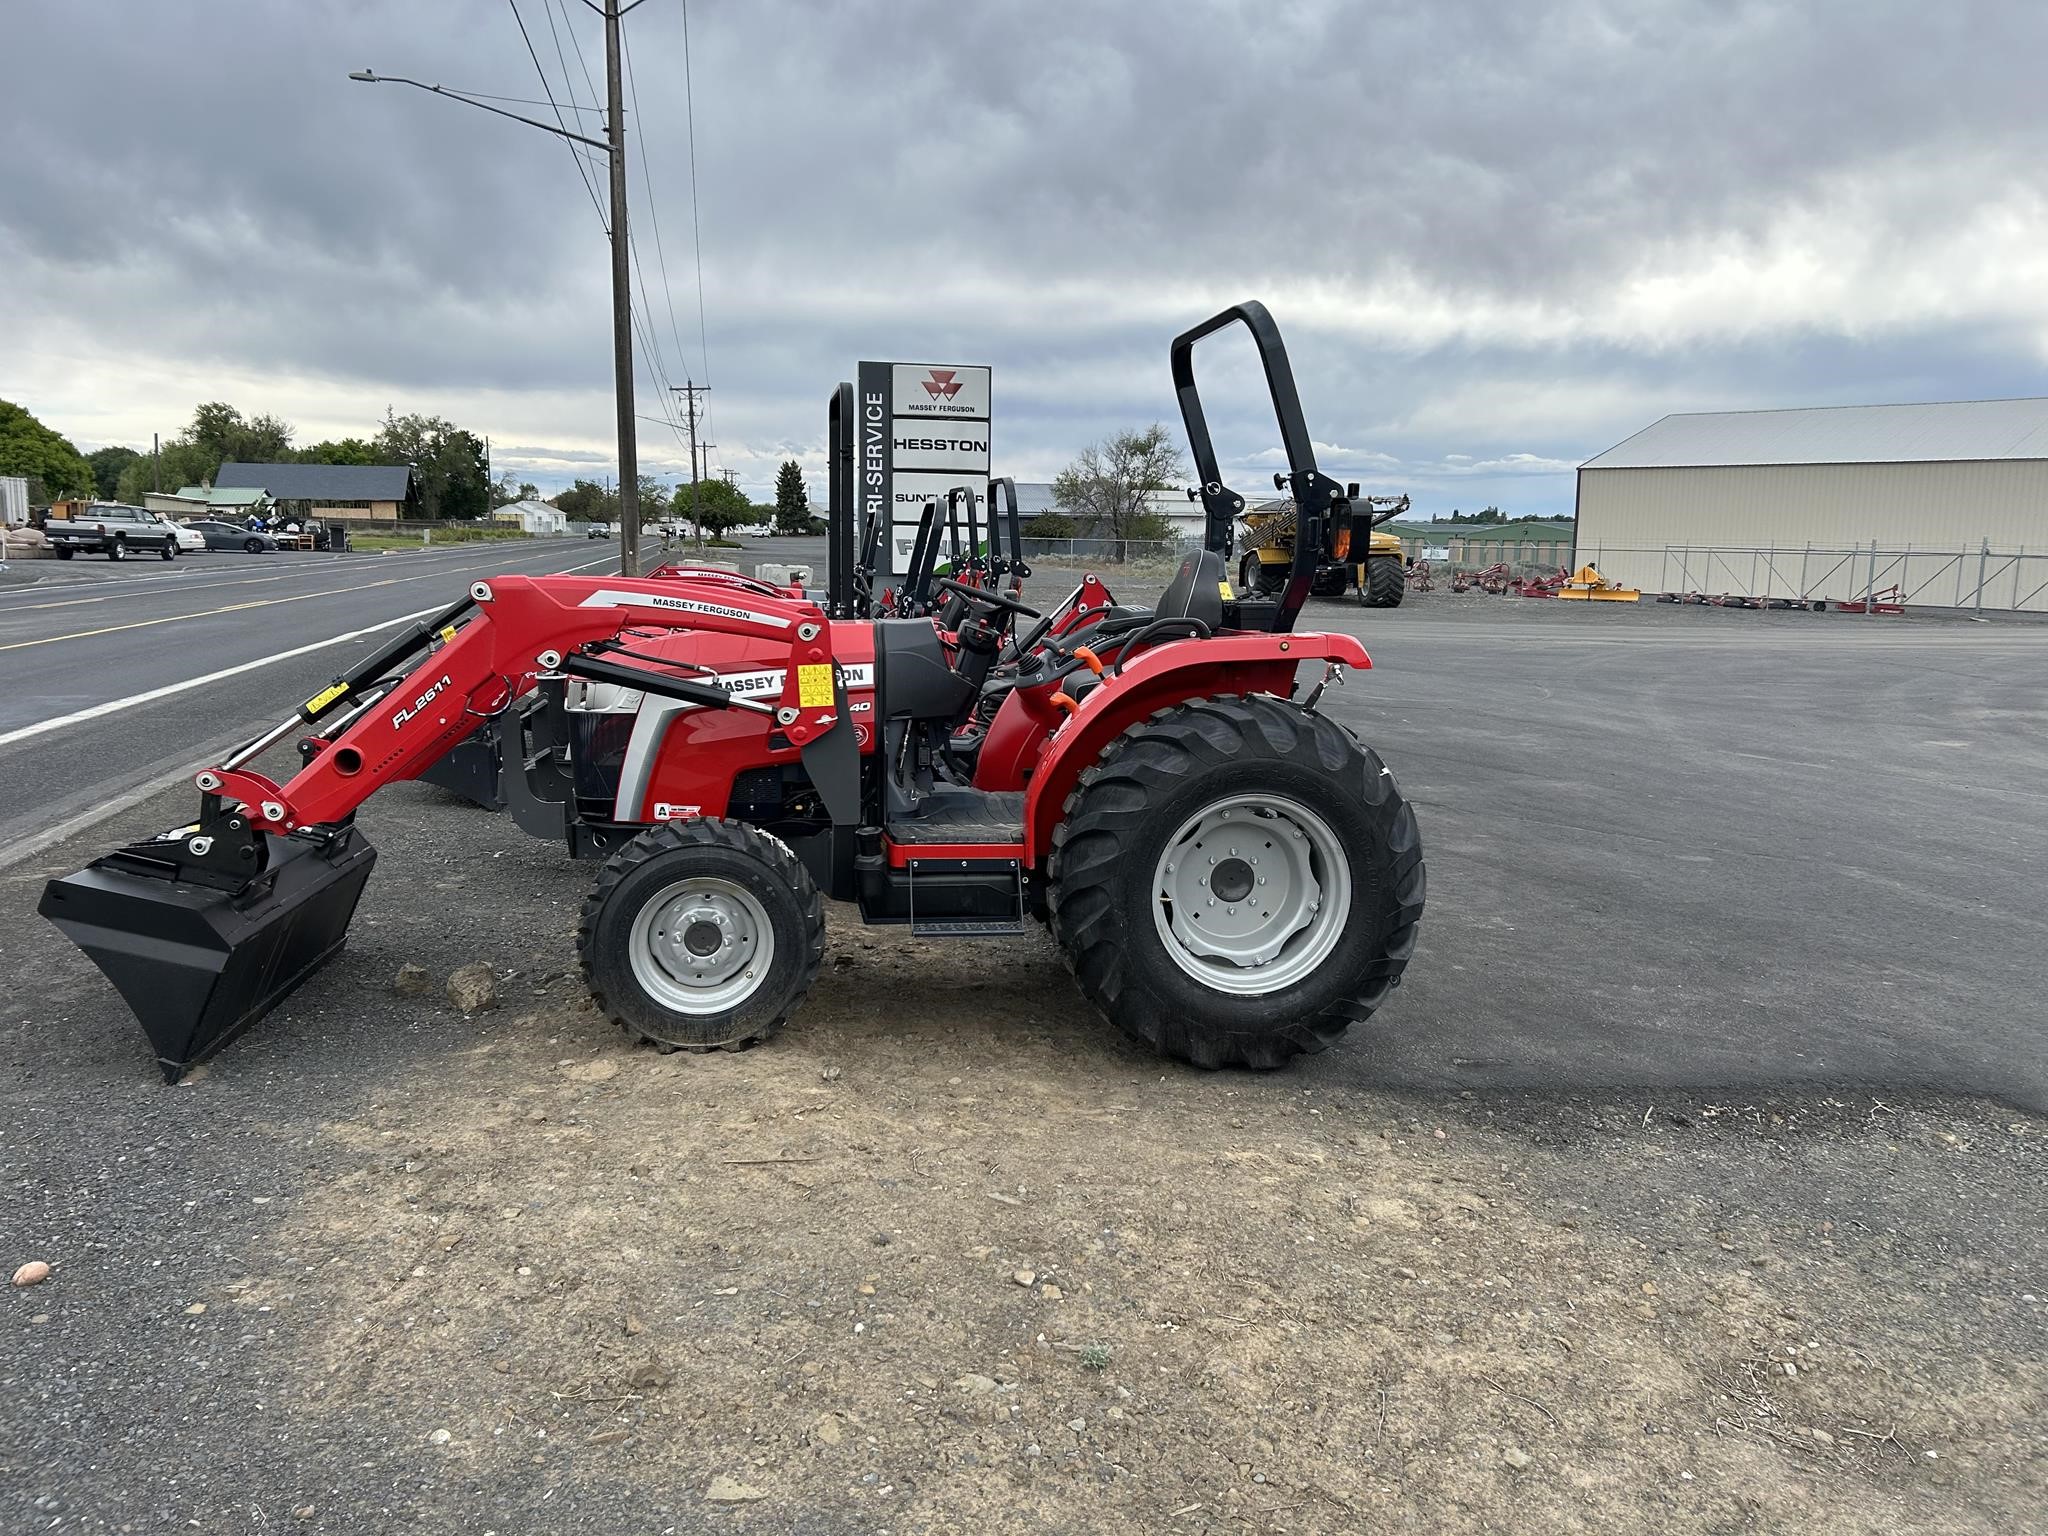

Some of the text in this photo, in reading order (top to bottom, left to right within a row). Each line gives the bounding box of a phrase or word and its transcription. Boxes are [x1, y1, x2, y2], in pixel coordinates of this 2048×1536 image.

[939, 405, 975, 413] FERGUSON
[894, 438, 987, 452] HESSTON
[866, 392, 883, 547] RI-SERVICE
[652, 598, 751, 620] MASSEY FERGUSON
[391, 674, 452, 730] FL.2611
[658, 806, 667, 816] A
